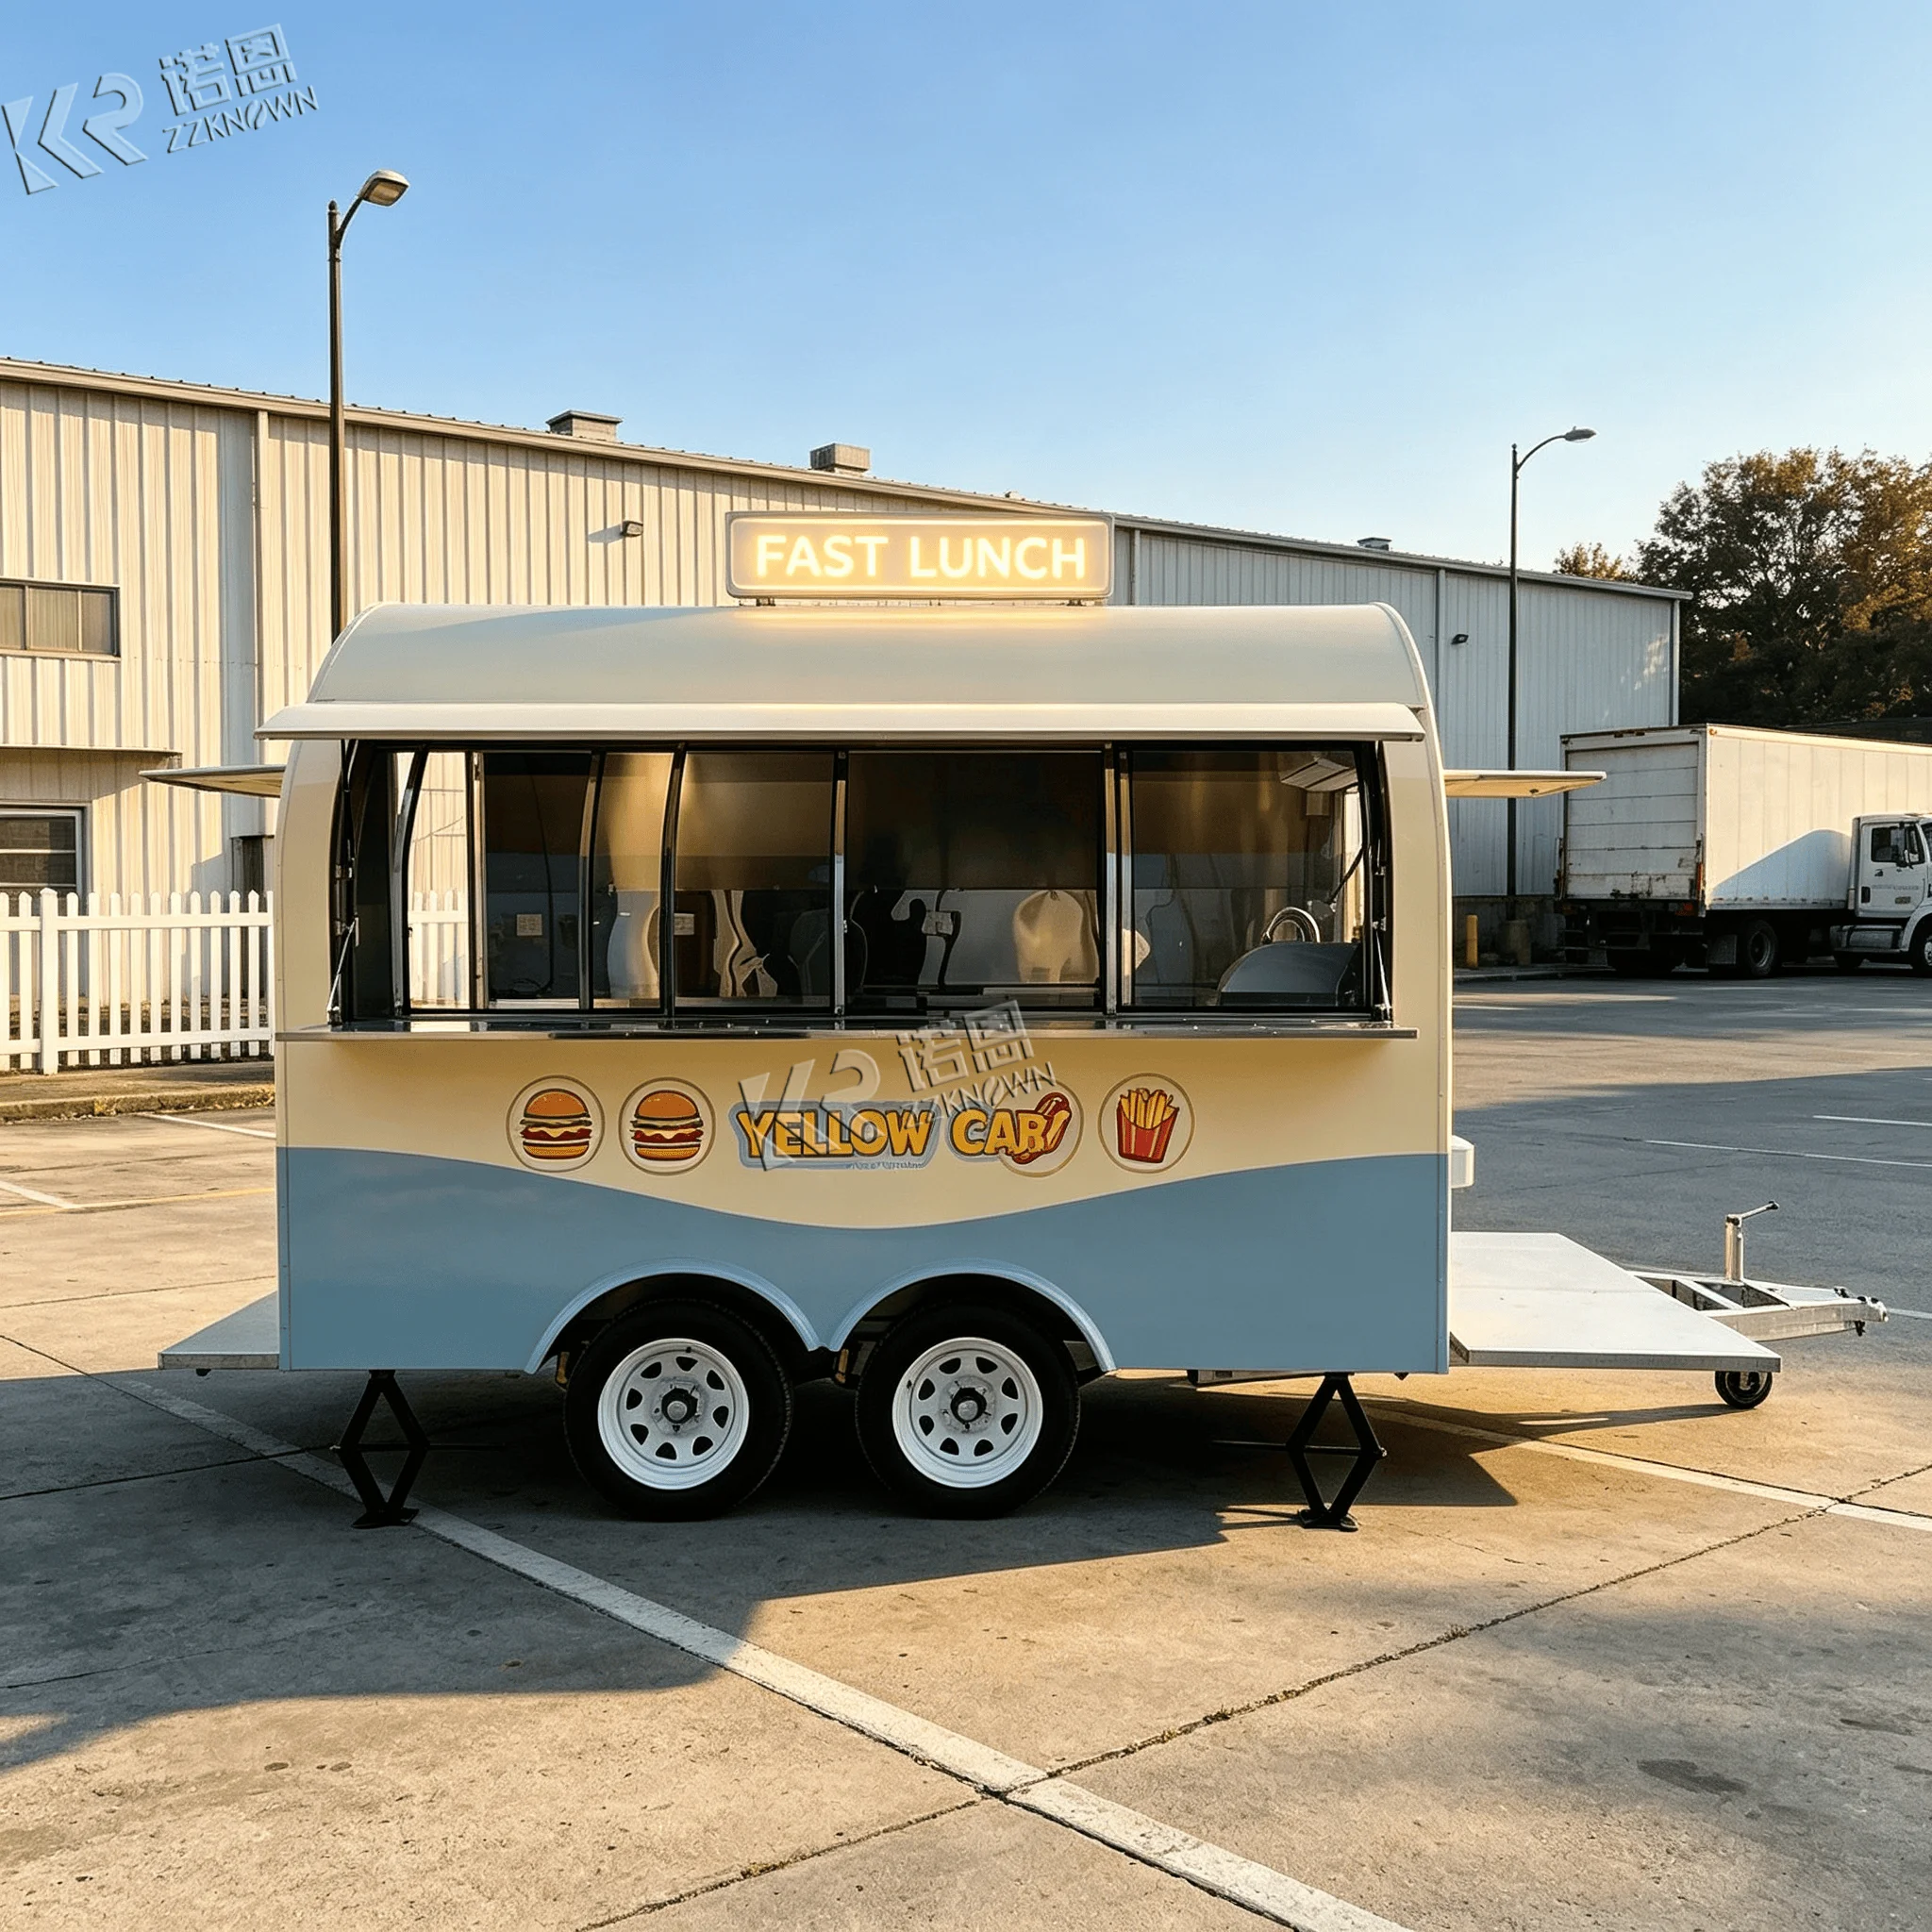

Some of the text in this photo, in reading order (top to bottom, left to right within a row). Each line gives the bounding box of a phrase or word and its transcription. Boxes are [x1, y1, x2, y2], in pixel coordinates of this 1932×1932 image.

[756, 534, 1086, 580] FAST LUNCH
[736, 1108, 936, 1158] YELLOW
